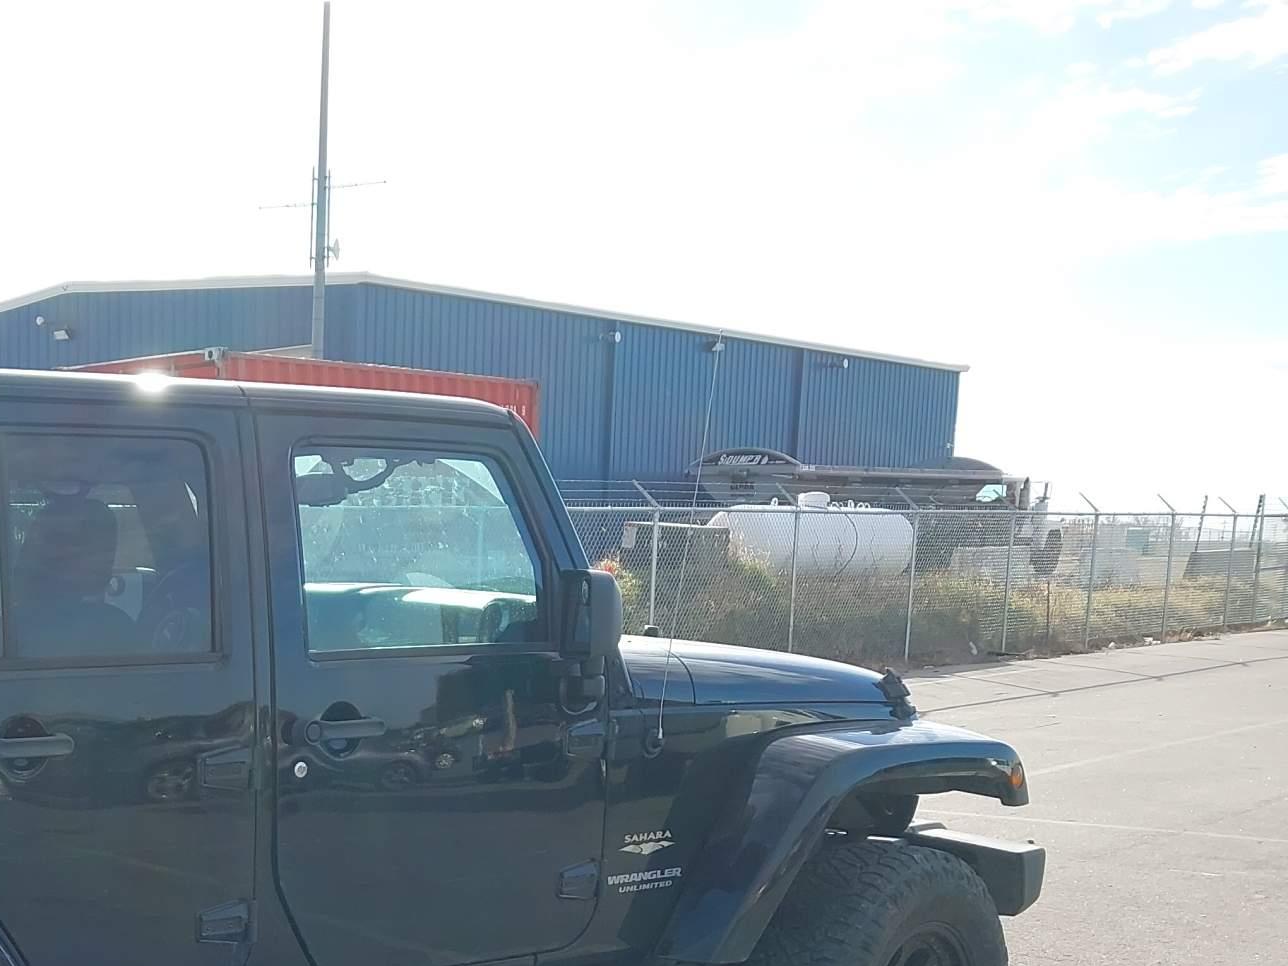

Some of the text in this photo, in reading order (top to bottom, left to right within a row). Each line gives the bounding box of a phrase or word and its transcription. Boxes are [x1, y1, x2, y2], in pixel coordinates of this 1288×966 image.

[624, 830, 672, 843] SAHARA
[607, 867, 682, 885] WRANGLER
[618, 880, 673, 893] UNLIMITED
